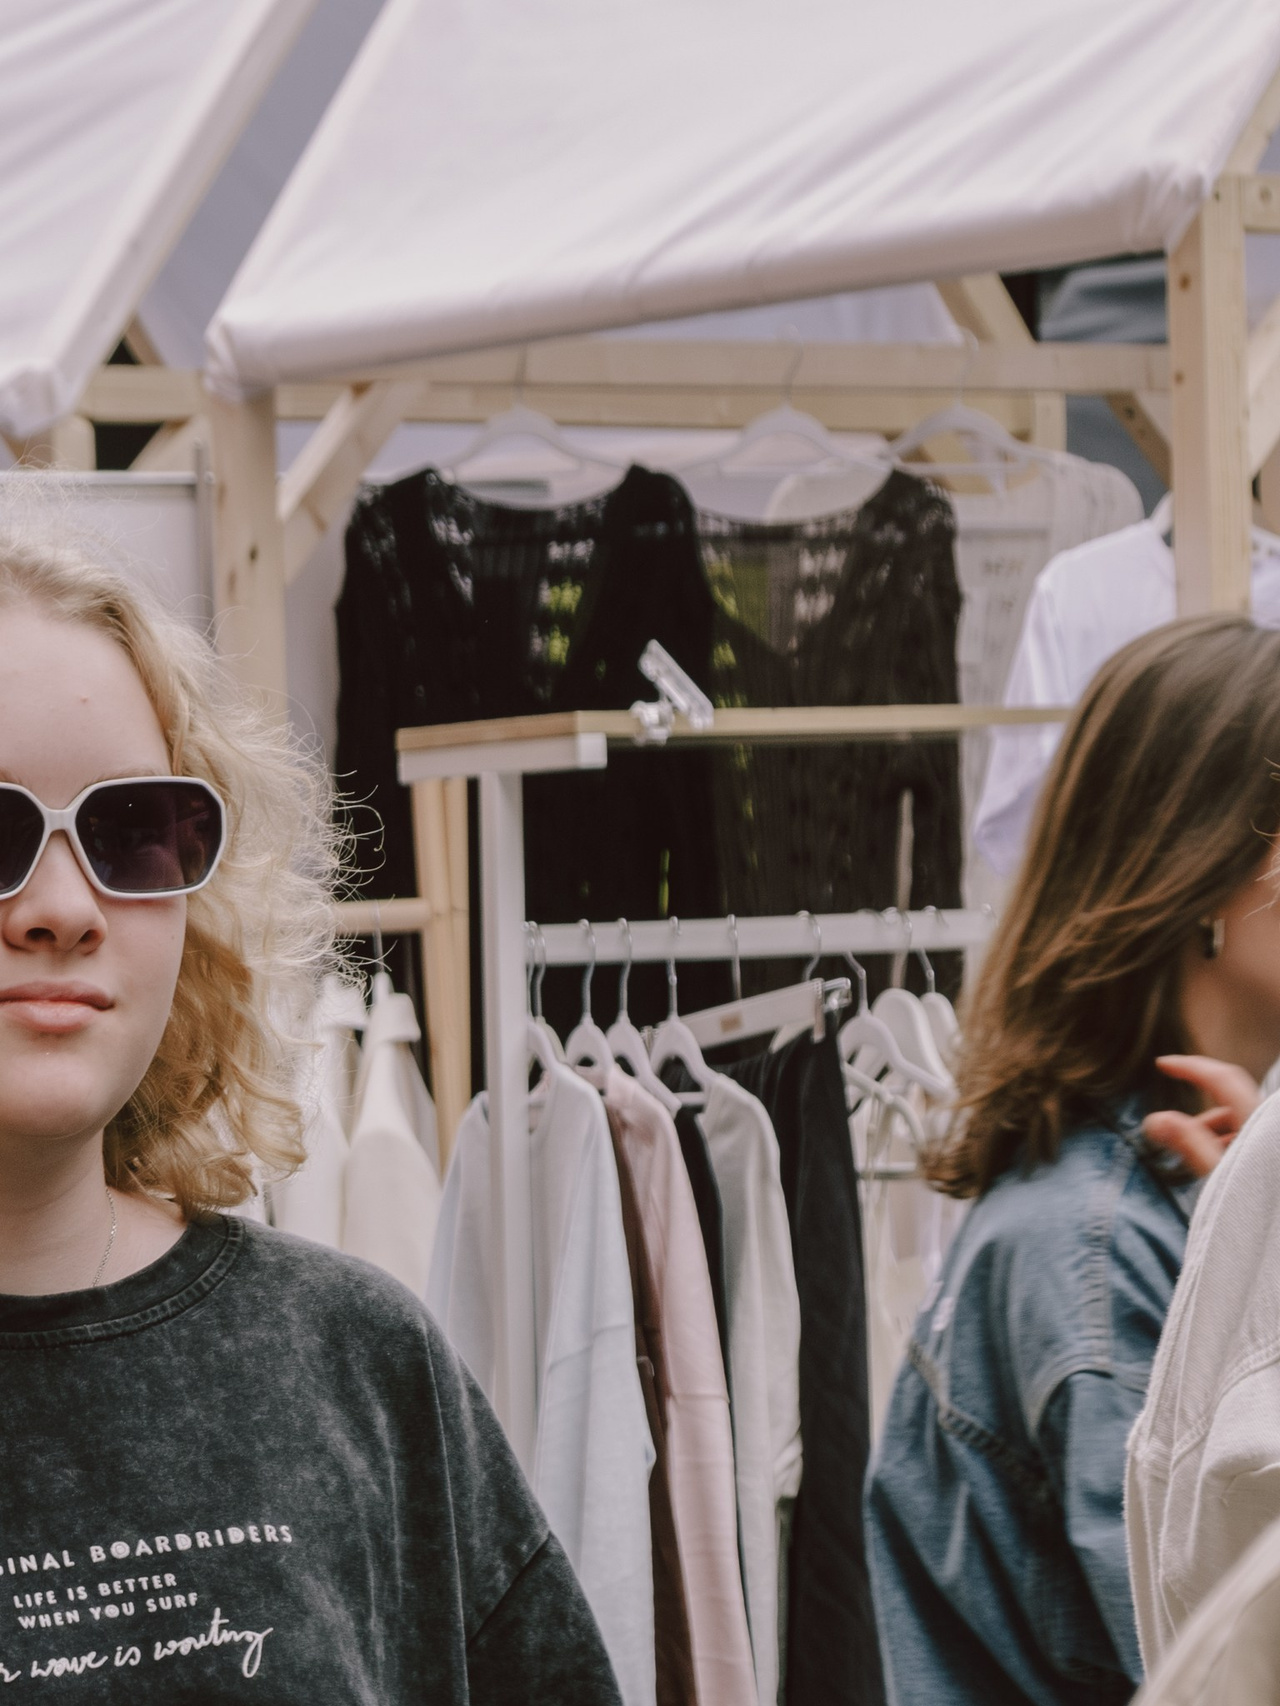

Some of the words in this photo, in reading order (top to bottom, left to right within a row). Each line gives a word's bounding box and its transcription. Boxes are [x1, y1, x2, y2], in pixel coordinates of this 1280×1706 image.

[90, 1524, 292, 1562] BOARDRIDERS
[14, 1591, 57, 1608] LIFE
[67, 1586, 87, 1601] IS
[98, 1573, 177, 1596] BETTER
[18, 1610, 79, 1628] WHEN
[89, 1602, 134, 1620] YOU
[146, 1593, 197, 1612] SURF
[31, 1652, 108, 1677] wave
[114, 1646, 141, 1666] is
